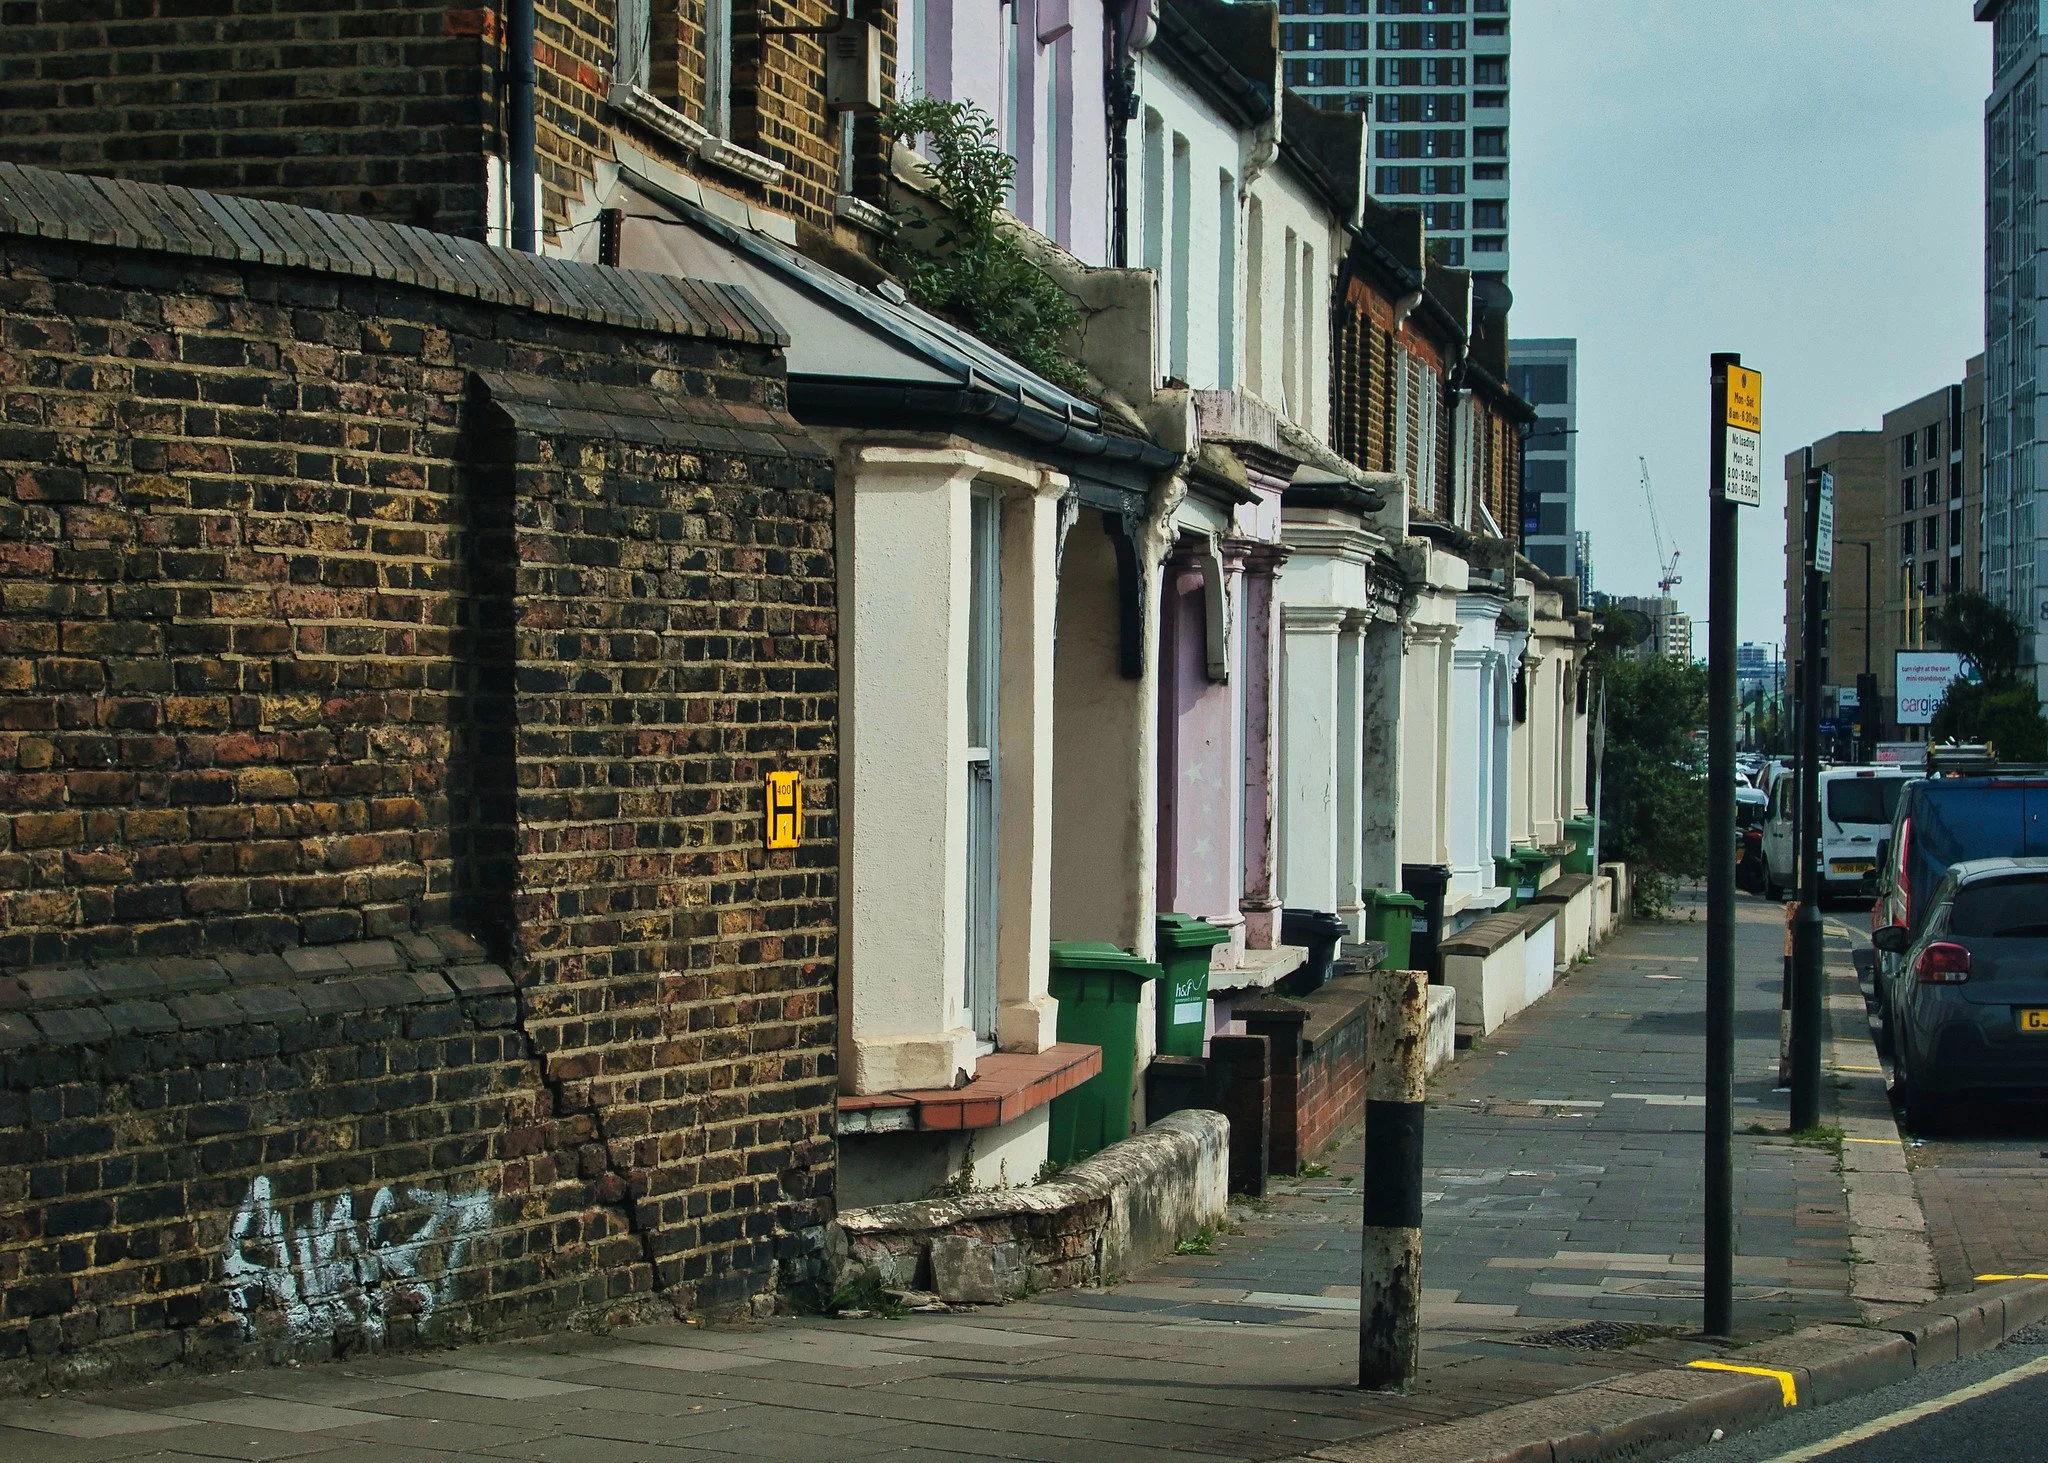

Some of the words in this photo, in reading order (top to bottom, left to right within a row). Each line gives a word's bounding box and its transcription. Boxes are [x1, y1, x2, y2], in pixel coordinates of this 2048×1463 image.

[1732, 433, 1738, 446] No
[1739, 435, 1755, 450] loading
[777, 785, 791, 795] 400
